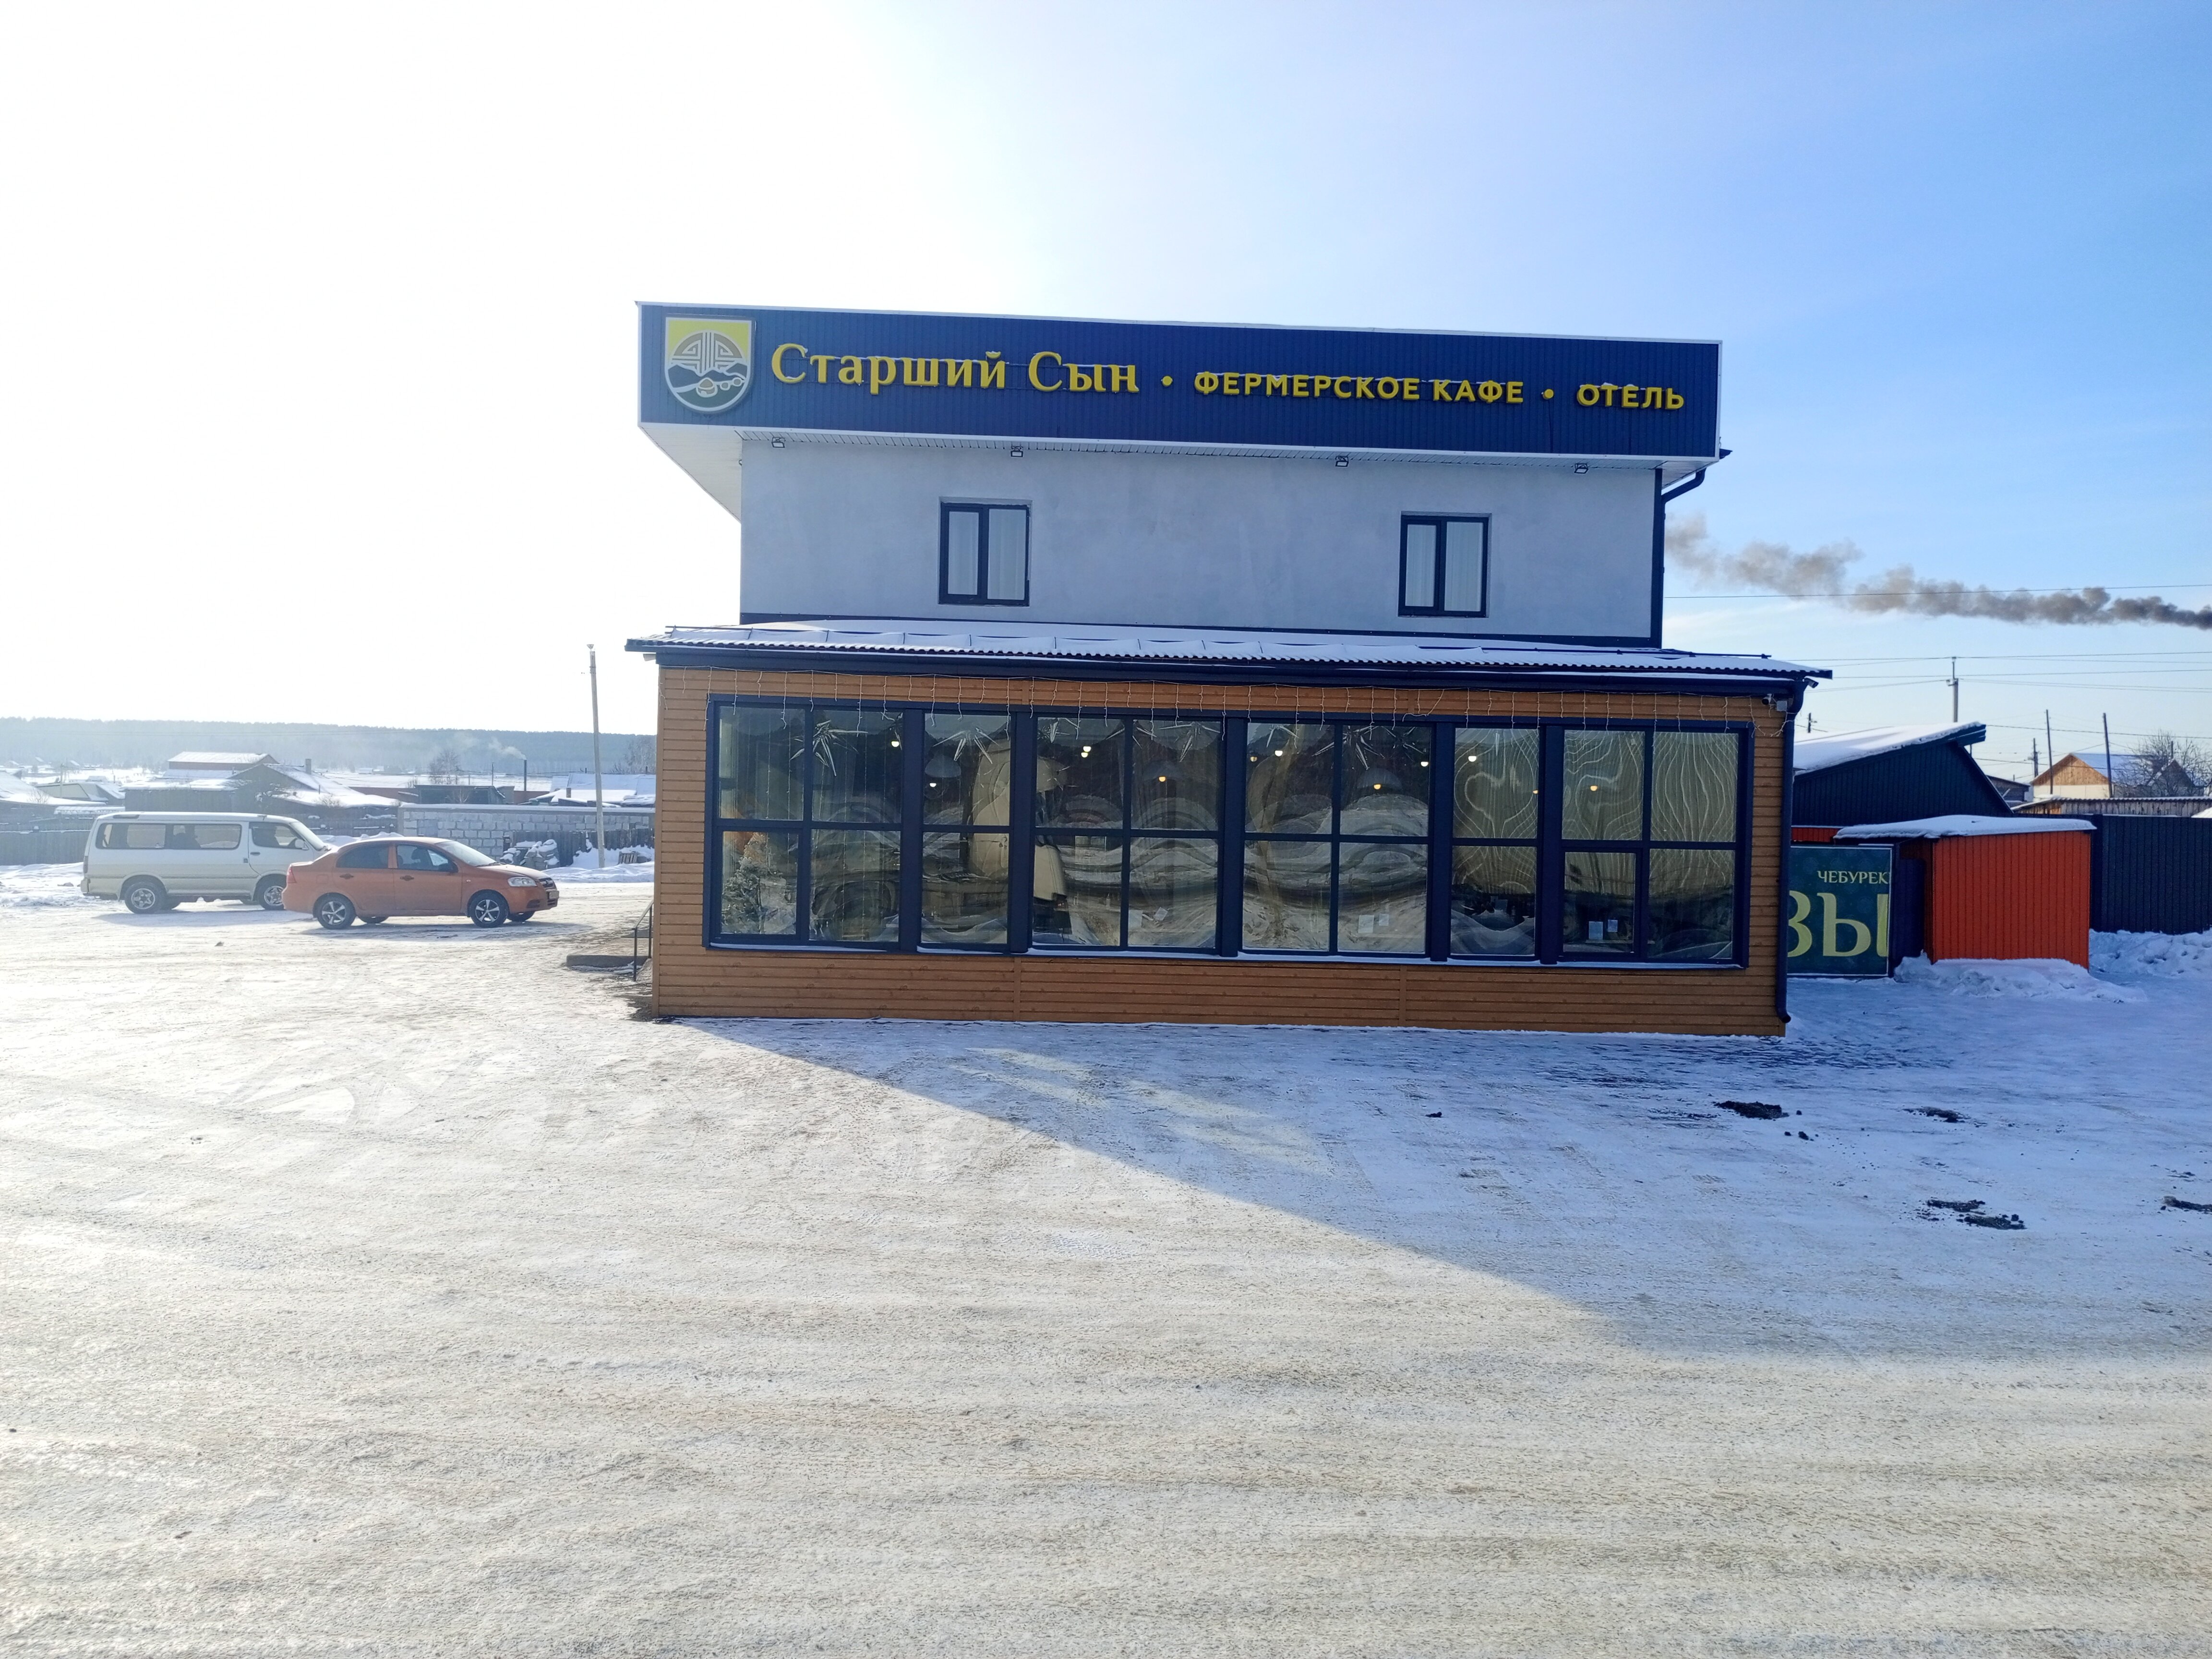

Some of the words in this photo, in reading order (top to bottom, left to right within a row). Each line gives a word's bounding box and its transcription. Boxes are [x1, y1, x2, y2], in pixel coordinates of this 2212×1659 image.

[771, 343, 1006, 395] Старший
[1028, 351, 1139, 393] Сын
[1194, 371, 1420, 400] ФЕРМЕРСКОЕ
[1433, 379, 1524, 404] КАФЕ
[1576, 384, 1684, 410] ОТЕЛЬ
[1817, 870, 1890, 884] ЧЕБУРЕК
